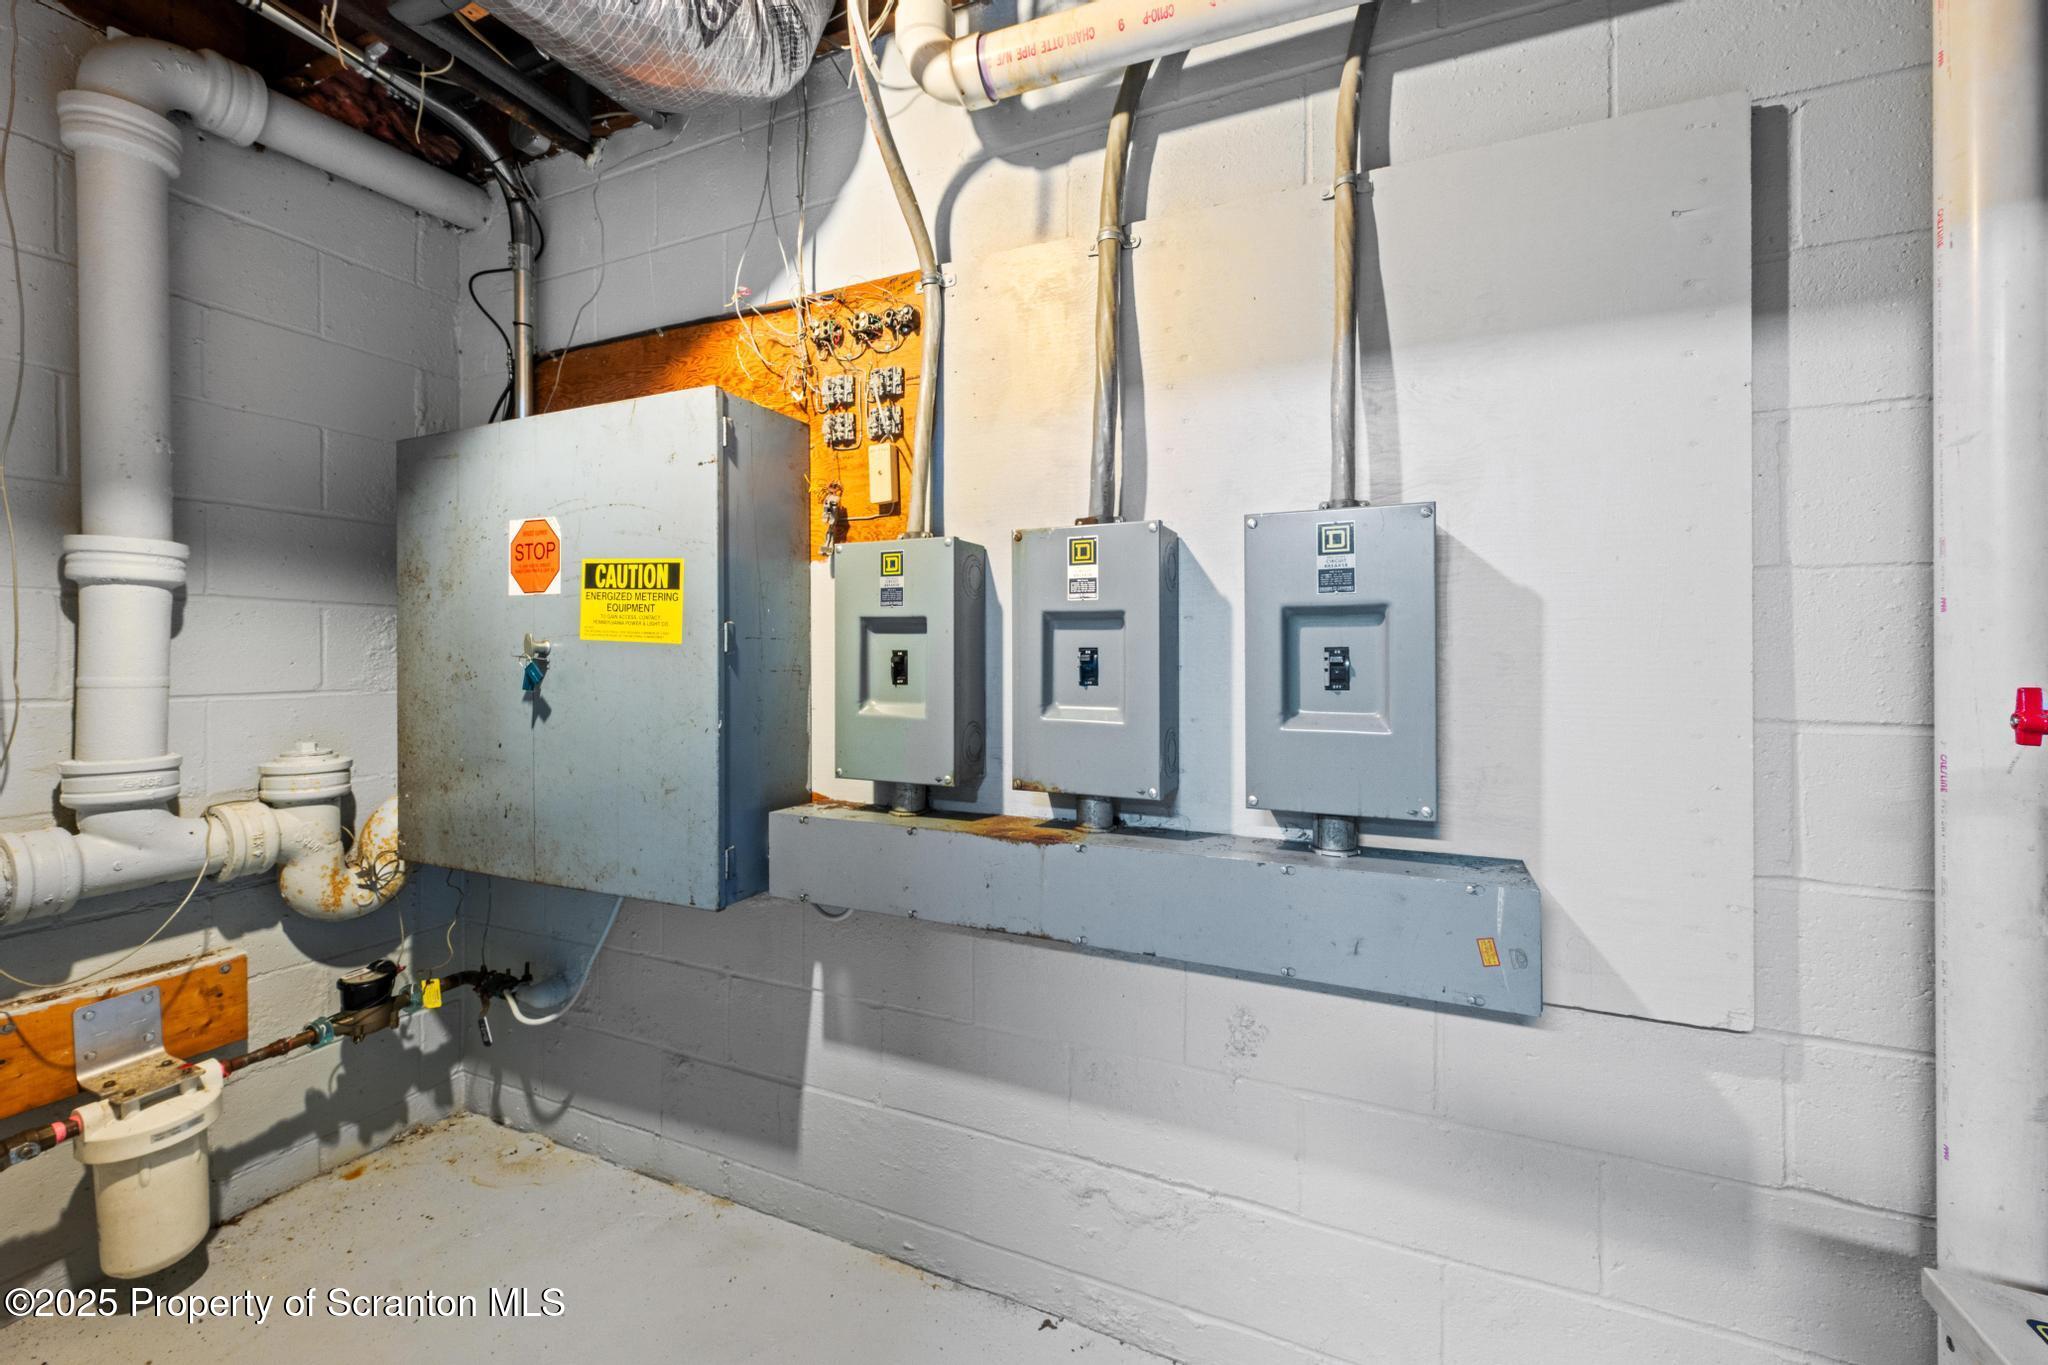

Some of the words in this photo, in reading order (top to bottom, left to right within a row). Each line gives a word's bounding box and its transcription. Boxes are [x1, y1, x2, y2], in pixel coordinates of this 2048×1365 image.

[515, 542, 556, 561] STOP
[595, 563, 669, 589] CAUTION
[585, 591, 633, 602] ENERGIZED
[634, 592, 679, 602] METERING
[606, 602, 656, 613] EQUIPMENT
